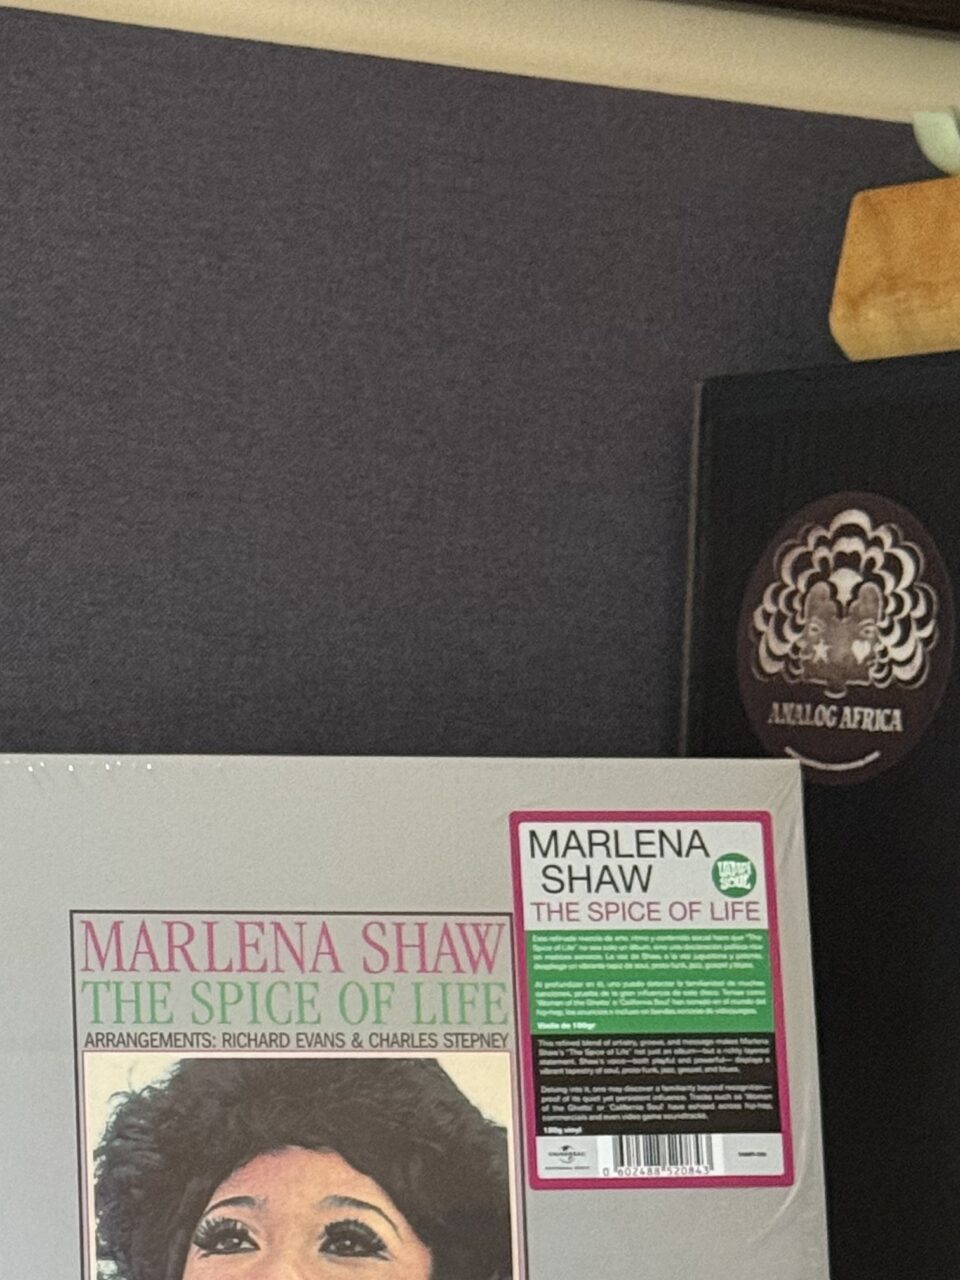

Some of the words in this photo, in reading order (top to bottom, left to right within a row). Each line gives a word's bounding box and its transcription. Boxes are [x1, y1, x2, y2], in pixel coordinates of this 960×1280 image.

[768, 702, 838, 727] ANALOG
[840, 705, 904, 732] AFRICA
[528, 829, 711, 859] MARLENA
[541, 864, 653, 894] SHAW
[530, 902, 580, 922] THE
[587, 902, 661, 922] SPICE
[668, 901, 702, 922] OF
[709, 901, 761, 921] LIFE
[80, 920, 344, 974] MARLENA
[362, 921, 507, 975] SHAW
[81, 980, 174, 1025] THE
[191, 980, 322, 1025] SPICE
[339, 980, 396, 1025] OF
[412, 981, 510, 1025] LIFE
[84, 1033, 217, 1049] ARRANGEMENTS:
[222, 1033, 290, 1048] RICHARD
[296, 1033, 345, 1048] EVANS
[351, 1033, 364, 1048] &
[368, 1033, 438, 1048] CHARLES
[442, 1032, 510, 1049] STEPNEY
